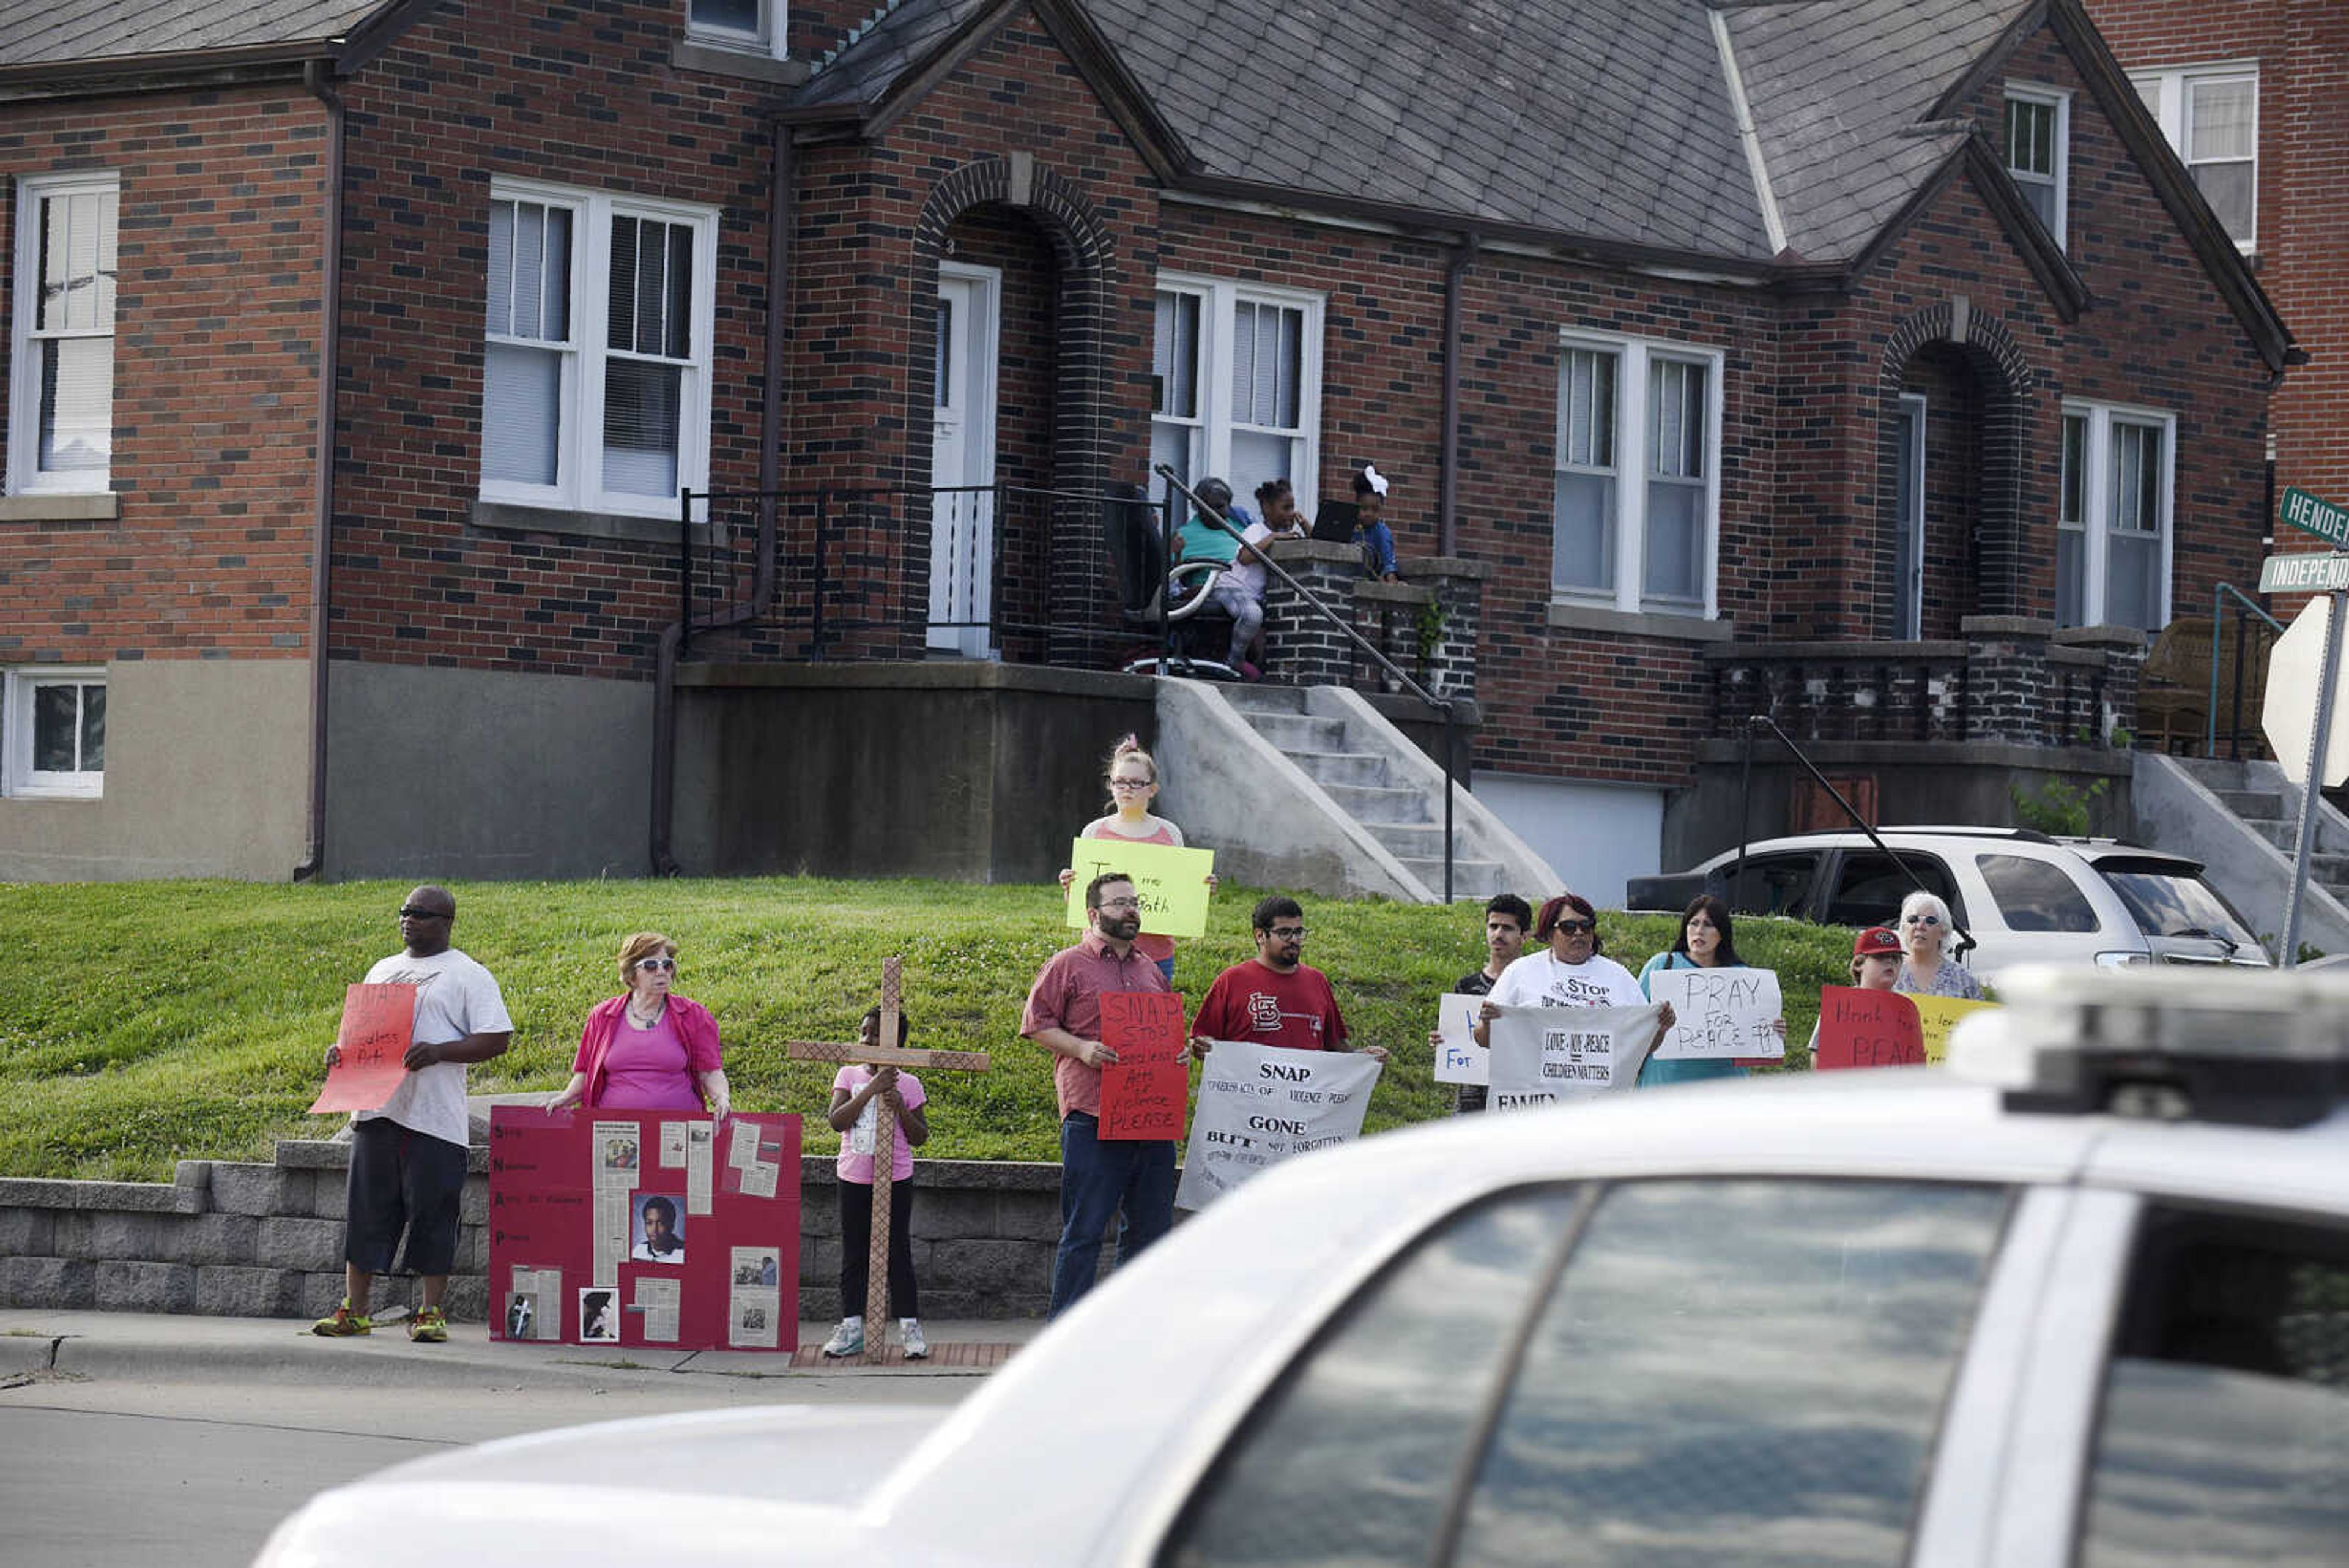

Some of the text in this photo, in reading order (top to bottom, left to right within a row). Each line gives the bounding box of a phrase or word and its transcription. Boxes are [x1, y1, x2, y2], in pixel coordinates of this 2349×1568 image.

[1685, 973, 1760, 1011] PRAY
[1447, 1048, 1472, 1069] For
[1260, 1063, 1311, 1082] SNAP
[1260, 1087, 1274, 1096] OF
[1249, 1115, 1307, 1136] GONE
[1207, 1131, 1257, 1148] BUT
